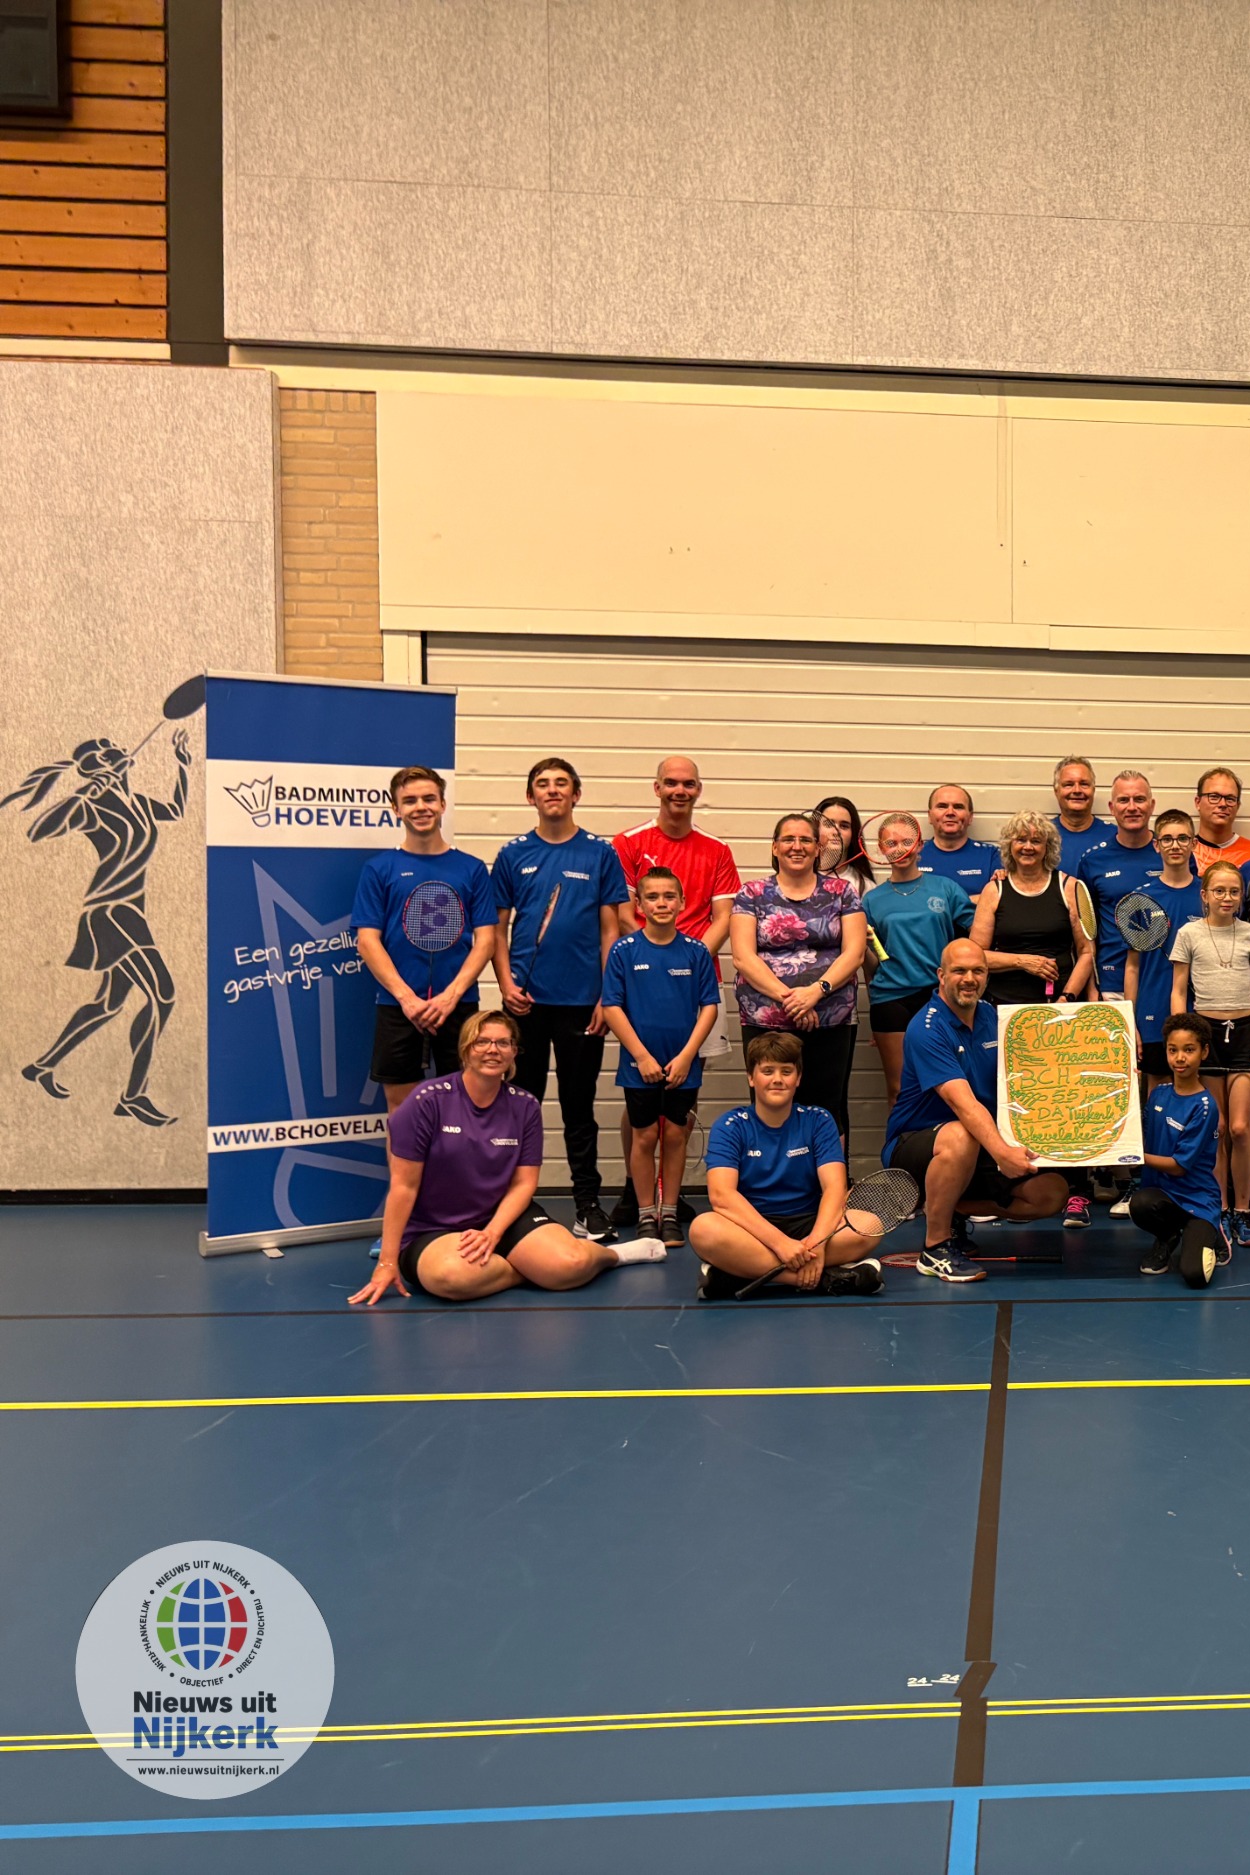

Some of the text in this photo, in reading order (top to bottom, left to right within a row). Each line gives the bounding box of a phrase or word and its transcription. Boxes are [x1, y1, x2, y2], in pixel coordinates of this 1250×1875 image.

[275, 807, 442, 828] HOEVELA
[234, 945, 280, 966] Een
[223, 957, 365, 1004] gastvrije ver
[1019, 1067, 1070, 1089] BCH
[1052, 1089, 1079, 1101] 55
[213, 1119, 388, 1146] WWW.BCHOEVELA
[940, 1673, 961, 1681] 24
